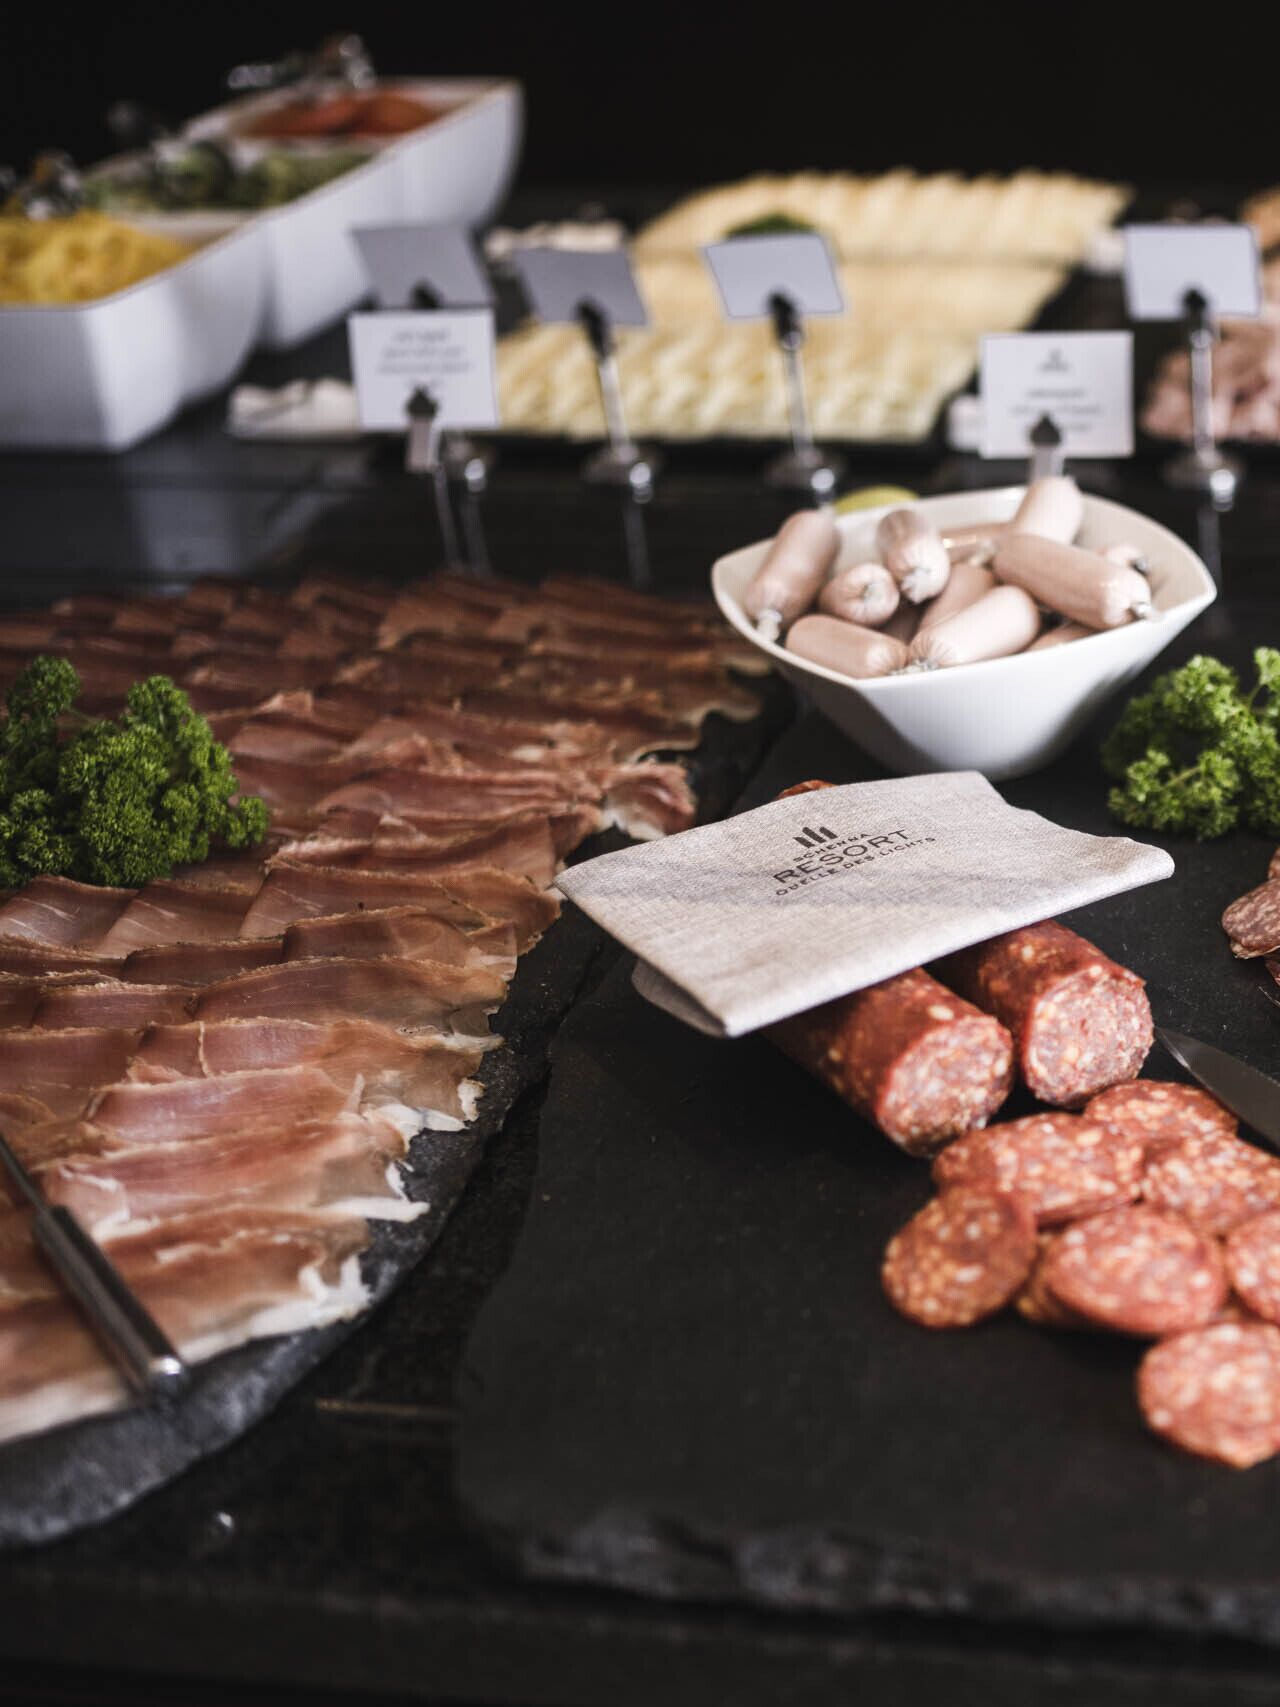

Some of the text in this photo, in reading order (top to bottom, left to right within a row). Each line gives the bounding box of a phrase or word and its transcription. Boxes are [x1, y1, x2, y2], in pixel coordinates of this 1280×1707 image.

[773, 829, 908, 884] RESORT
[793, 833, 870, 863] SCHENNA
[776, 867, 840, 896] QUELLE
[844, 855, 875, 870] DES
